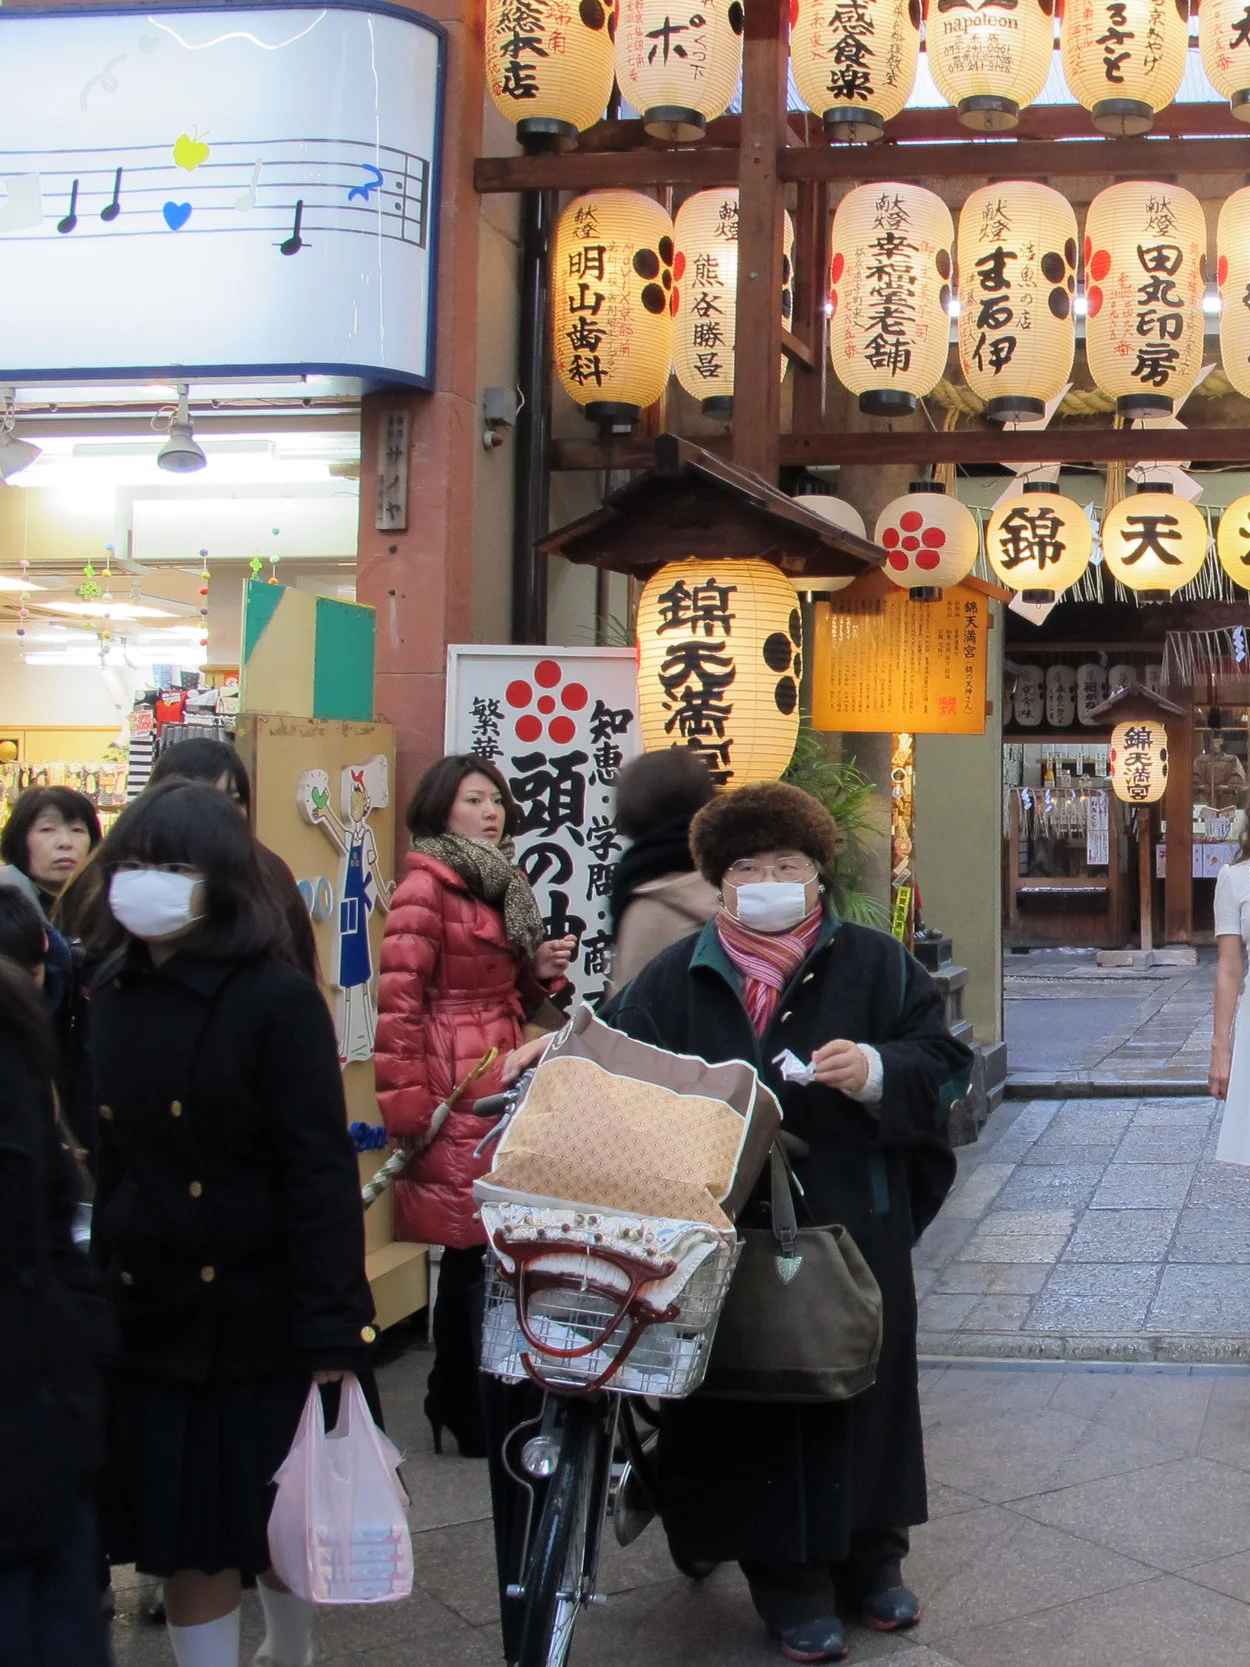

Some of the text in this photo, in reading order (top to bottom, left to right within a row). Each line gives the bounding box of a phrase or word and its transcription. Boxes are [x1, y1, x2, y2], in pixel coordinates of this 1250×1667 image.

[645, 14, 707, 67] ポ
[943, 12, 1019, 34] napoleon
[571, 204, 601, 241] 献燈
[872, 192, 914, 233] 献燈
[979, 199, 1013, 243] 献燈
[1143, 194, 1180, 240] 献燈
[565, 244, 609, 388] 明山歯科
[689, 253, 727, 380] 熊谷勝昌
[865, 231, 920, 378] 幸福堂老舗
[1130, 243, 1186, 388] 田丸印房
[1000, 507, 1067, 572] 錦
[1120, 514, 1184, 567] 天
[656, 577, 738, 786] 錦天満宮
[1123, 726, 1153, 800] 錦天満宮
